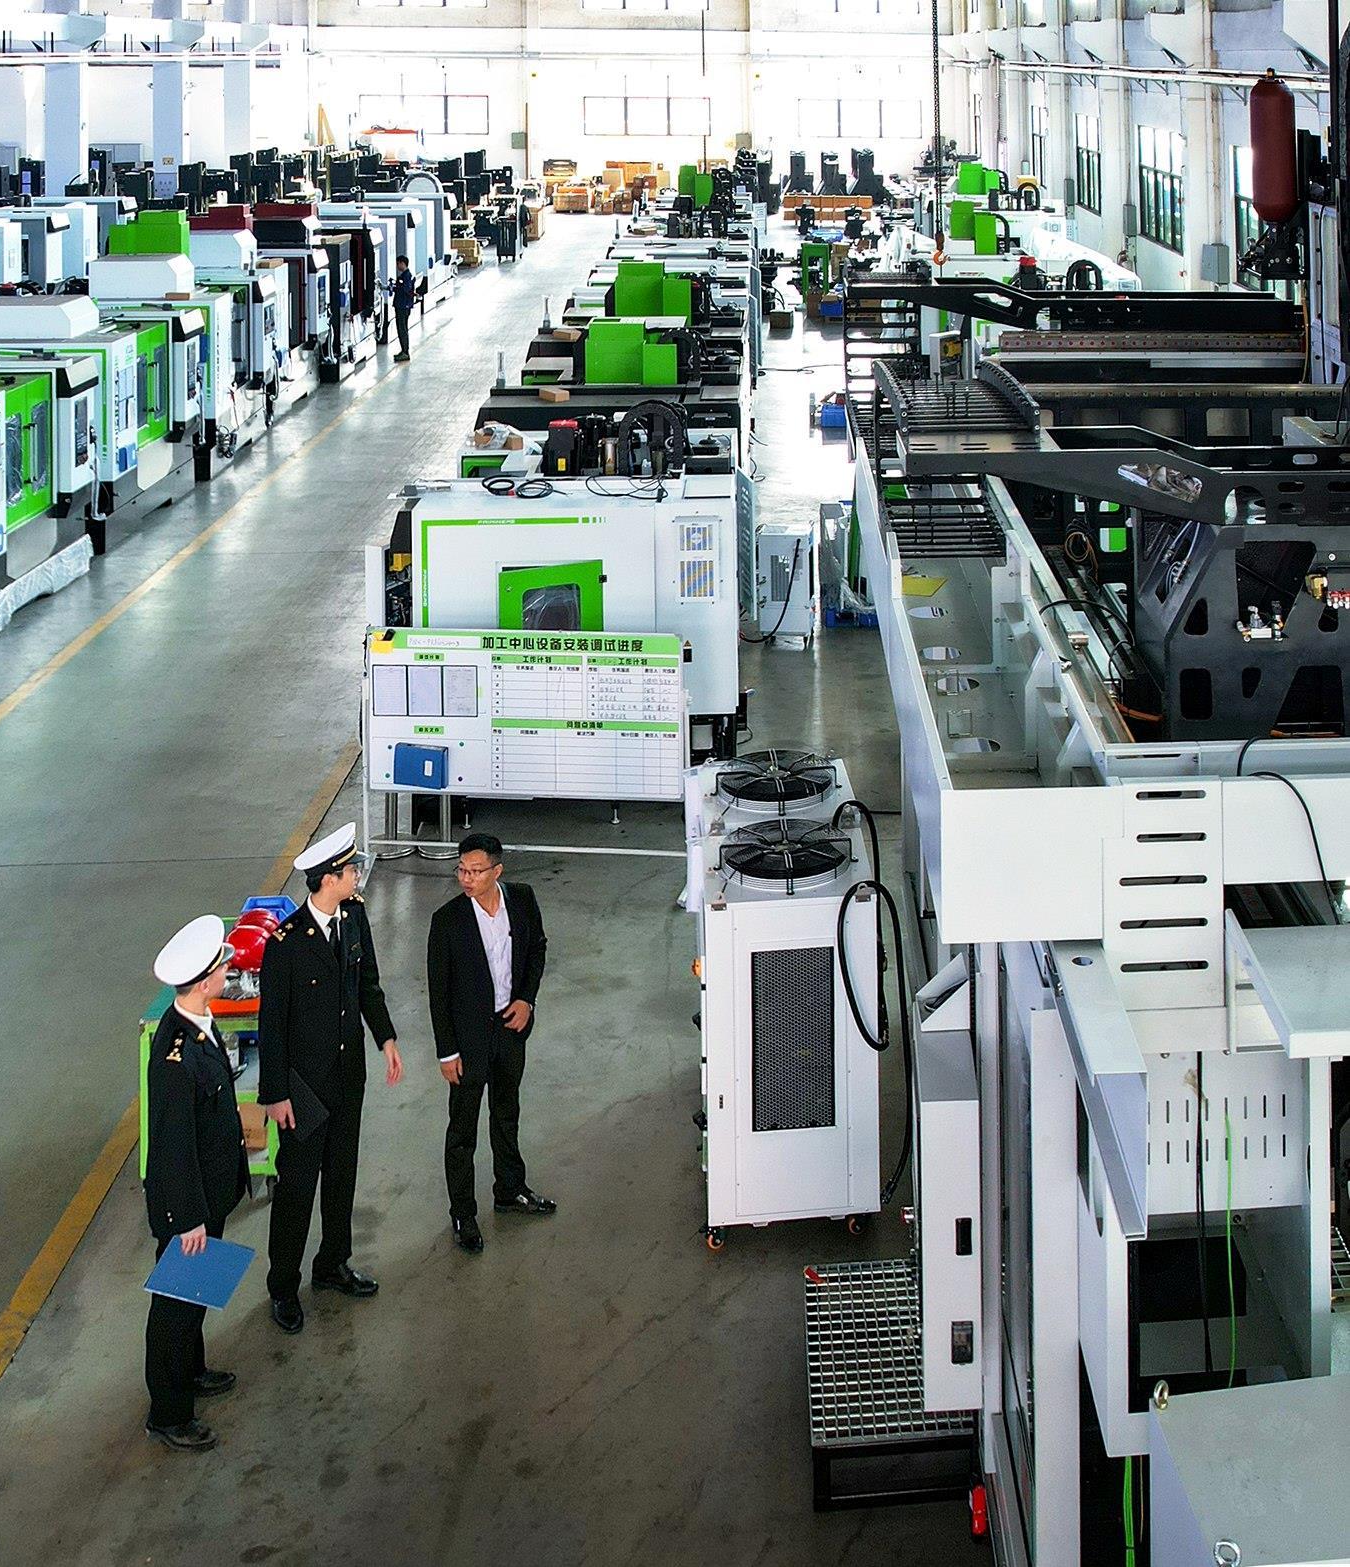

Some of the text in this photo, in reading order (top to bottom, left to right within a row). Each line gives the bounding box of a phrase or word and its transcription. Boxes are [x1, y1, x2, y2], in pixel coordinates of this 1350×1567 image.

[482, 636, 643, 652] 加工中心设备安装调试进度
